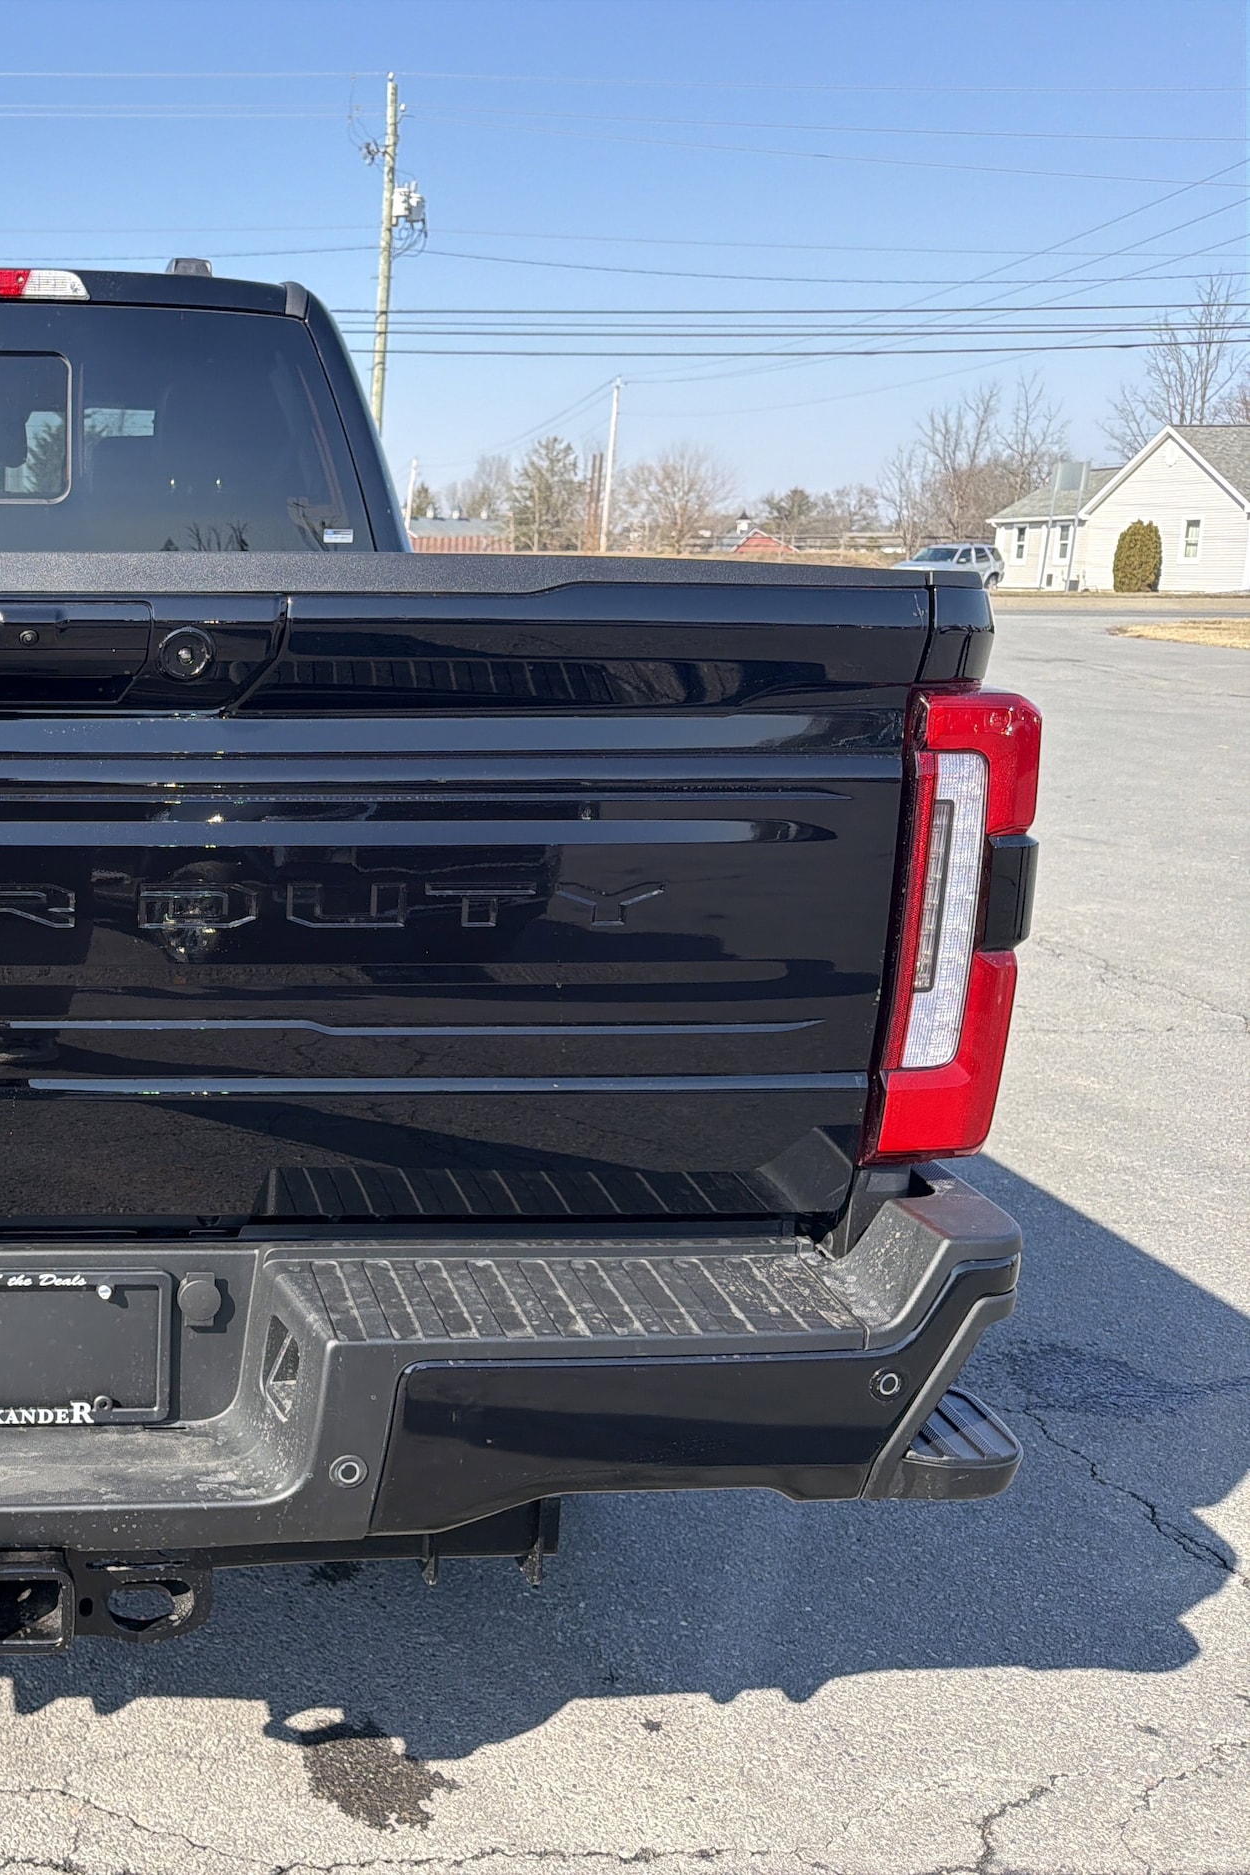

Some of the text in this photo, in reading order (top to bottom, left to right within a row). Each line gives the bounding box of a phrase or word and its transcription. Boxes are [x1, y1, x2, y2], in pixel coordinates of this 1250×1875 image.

[138, 882, 667, 928] DUTY
[7, 1274, 33, 1287] the
[38, 1273, 87, 1287] Deals
